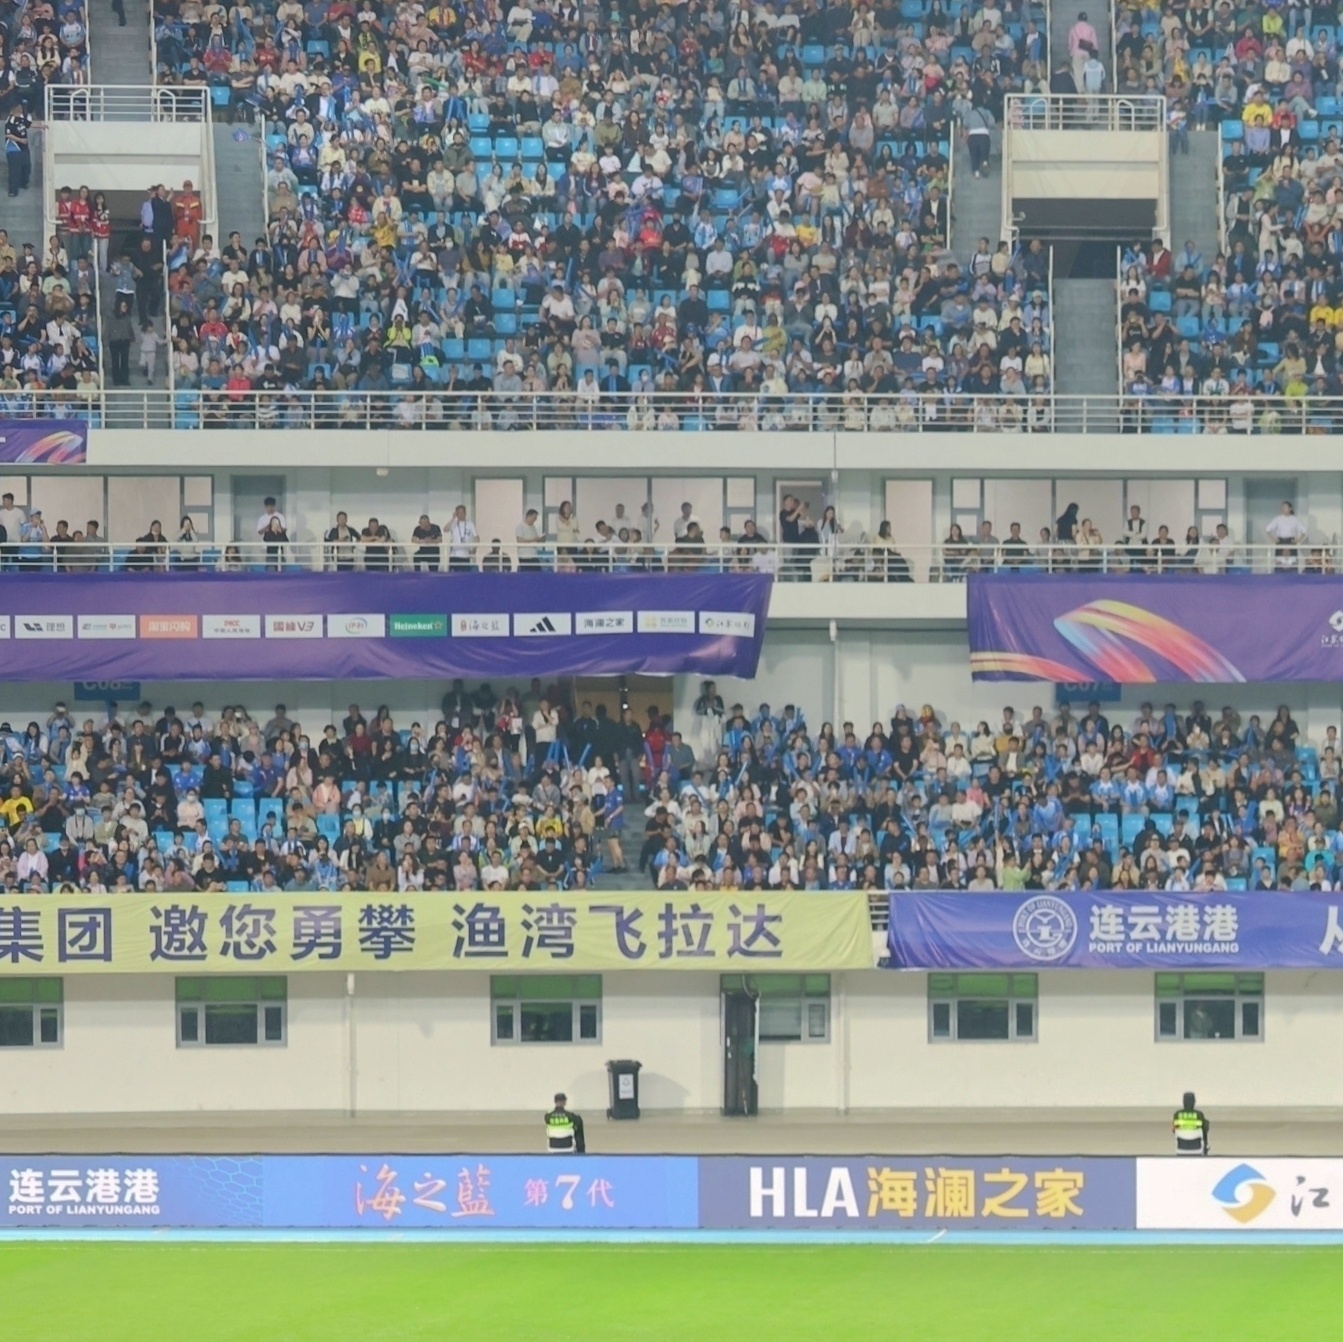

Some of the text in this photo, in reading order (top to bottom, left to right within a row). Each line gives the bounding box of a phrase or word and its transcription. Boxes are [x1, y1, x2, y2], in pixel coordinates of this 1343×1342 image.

[394, 619, 434, 632] Heineken
[0, 903, 785, 964] 集团 邀您勇攀 渔湾飞拉达
[1089, 903, 1239, 942] 连云港港
[1089, 942, 1240, 954] PORT OF LIANYUNGANG
[9, 1167, 160, 1203] 连云港港
[523, 1173, 615, 1210] 第7代
[749, 1165, 1086, 1219] HLA 海澜之家
[9, 1204, 160, 1215] PORT OF LIANYUNGANG
